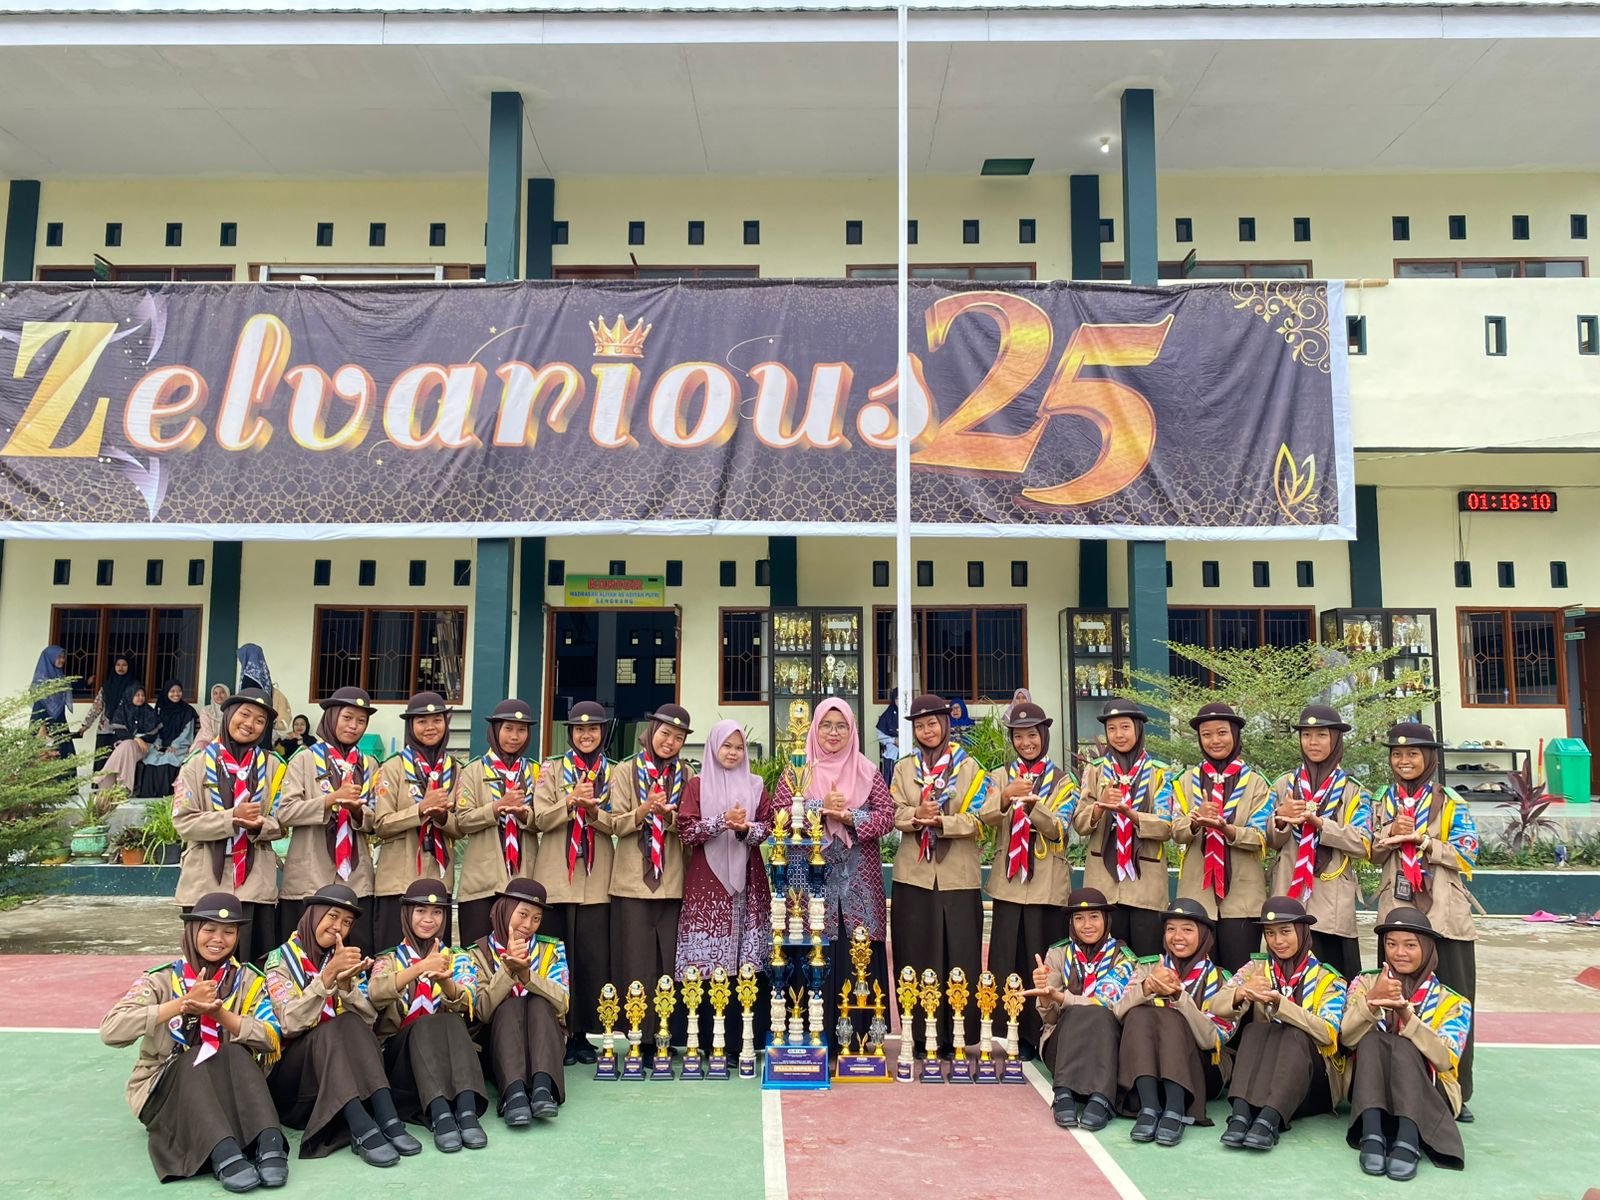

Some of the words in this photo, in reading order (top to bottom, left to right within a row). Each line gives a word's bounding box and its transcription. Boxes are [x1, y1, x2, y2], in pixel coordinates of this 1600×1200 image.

[0, 314, 939, 458] Zelvarious
[908, 290, 1175, 506] 25
[1467, 492, 1552, 510] 01:18:10
[589, 579, 643, 590] KANTOR
